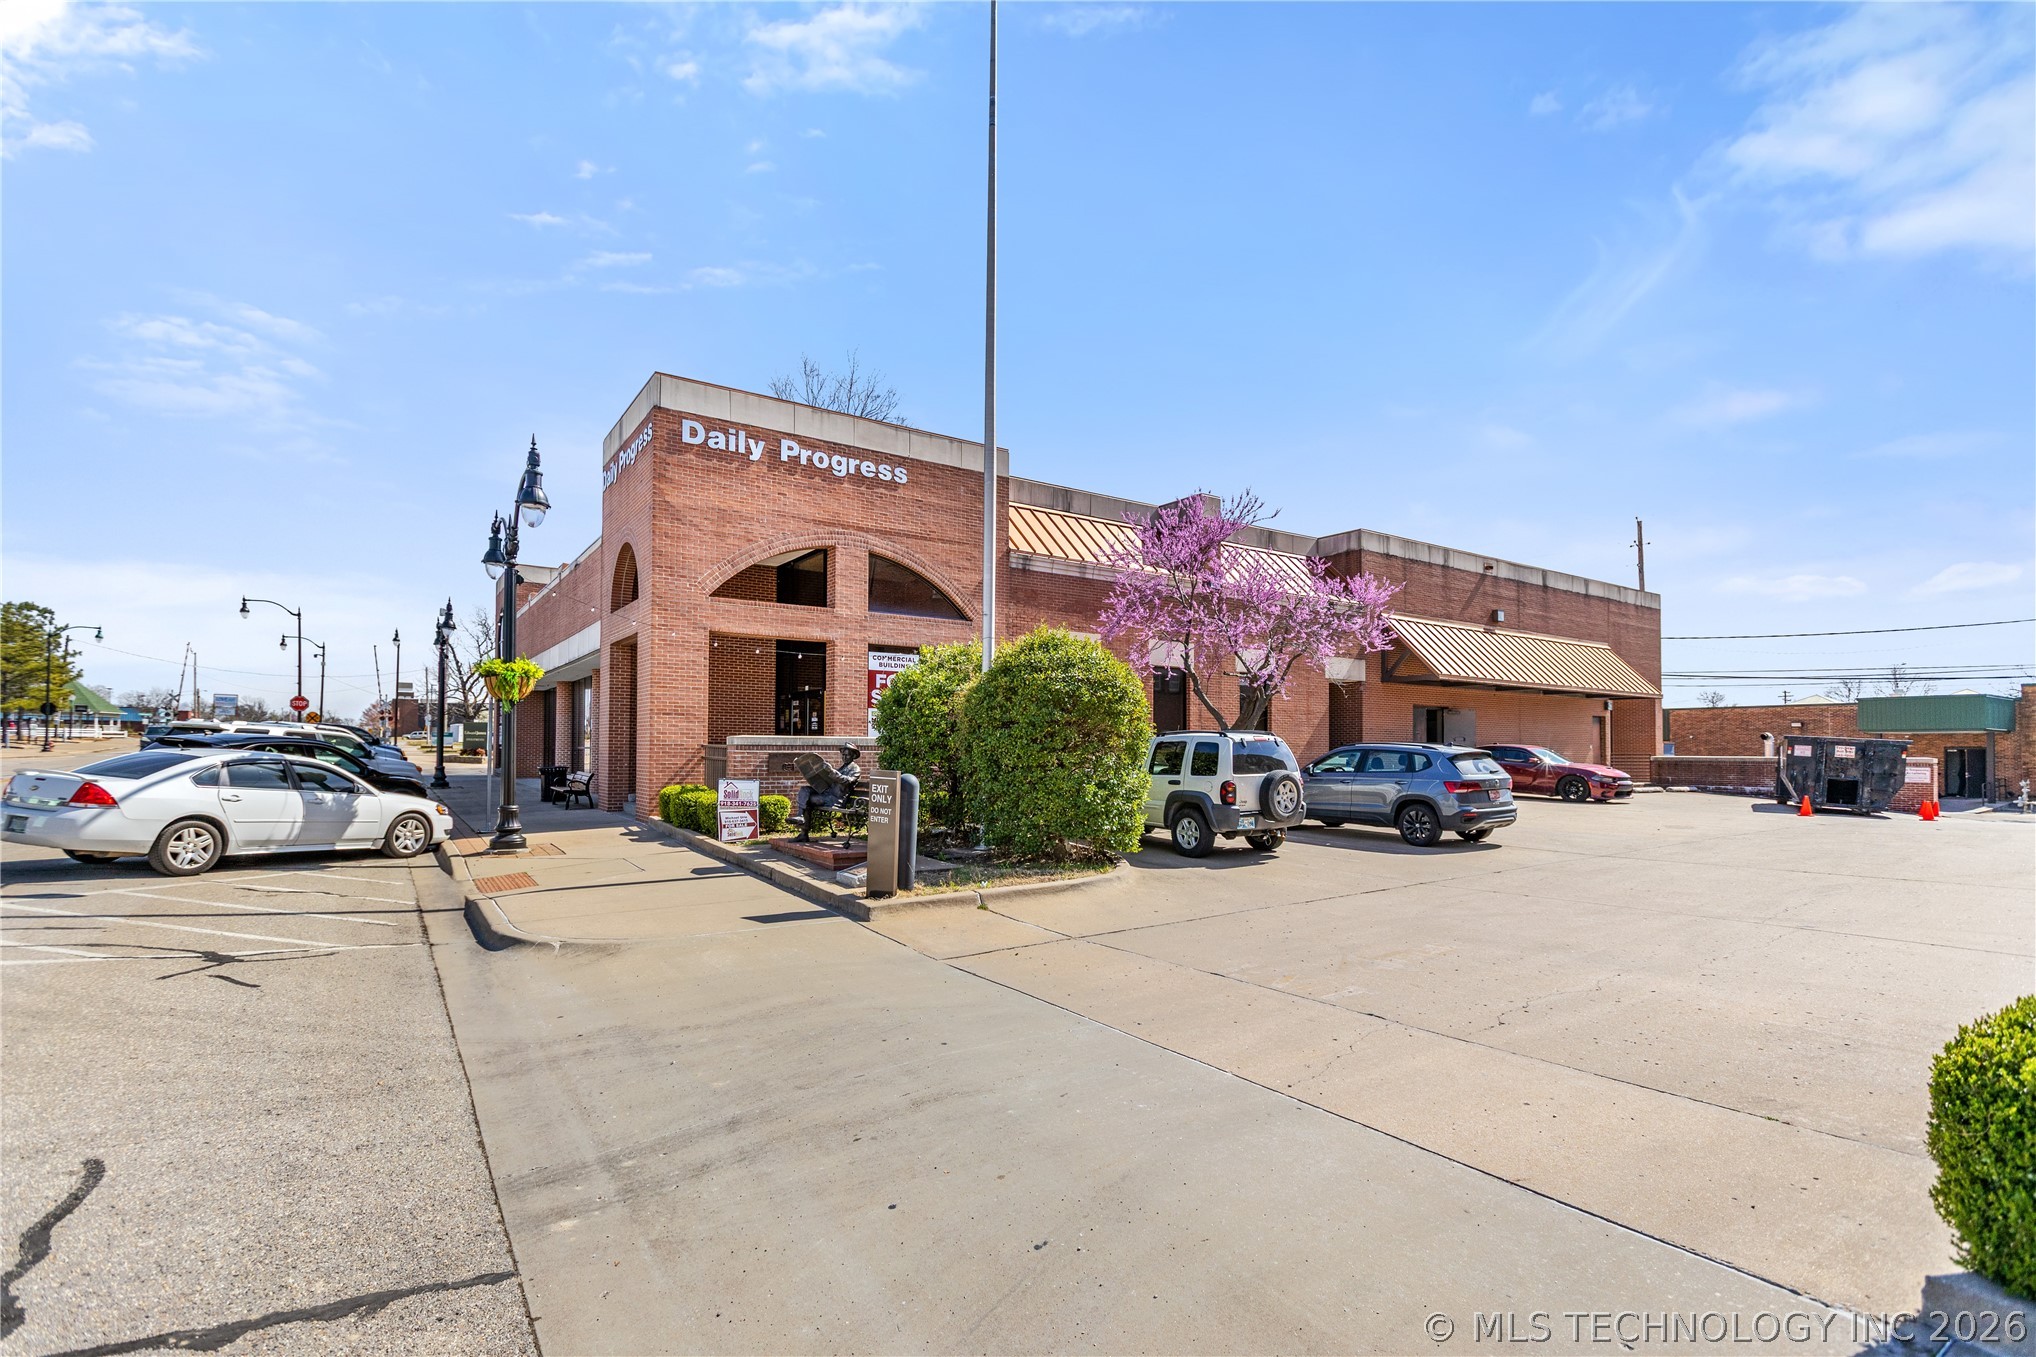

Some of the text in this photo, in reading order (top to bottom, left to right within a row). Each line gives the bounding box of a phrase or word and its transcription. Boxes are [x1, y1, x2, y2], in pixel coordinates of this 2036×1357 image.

[603, 422, 653, 491] Daily Progress
[681, 419, 908, 484] Daily Progress
[871, 784, 889, 794] EXIT
[871, 793, 892, 804] ONLY
[870, 816, 889, 824] ENTER
